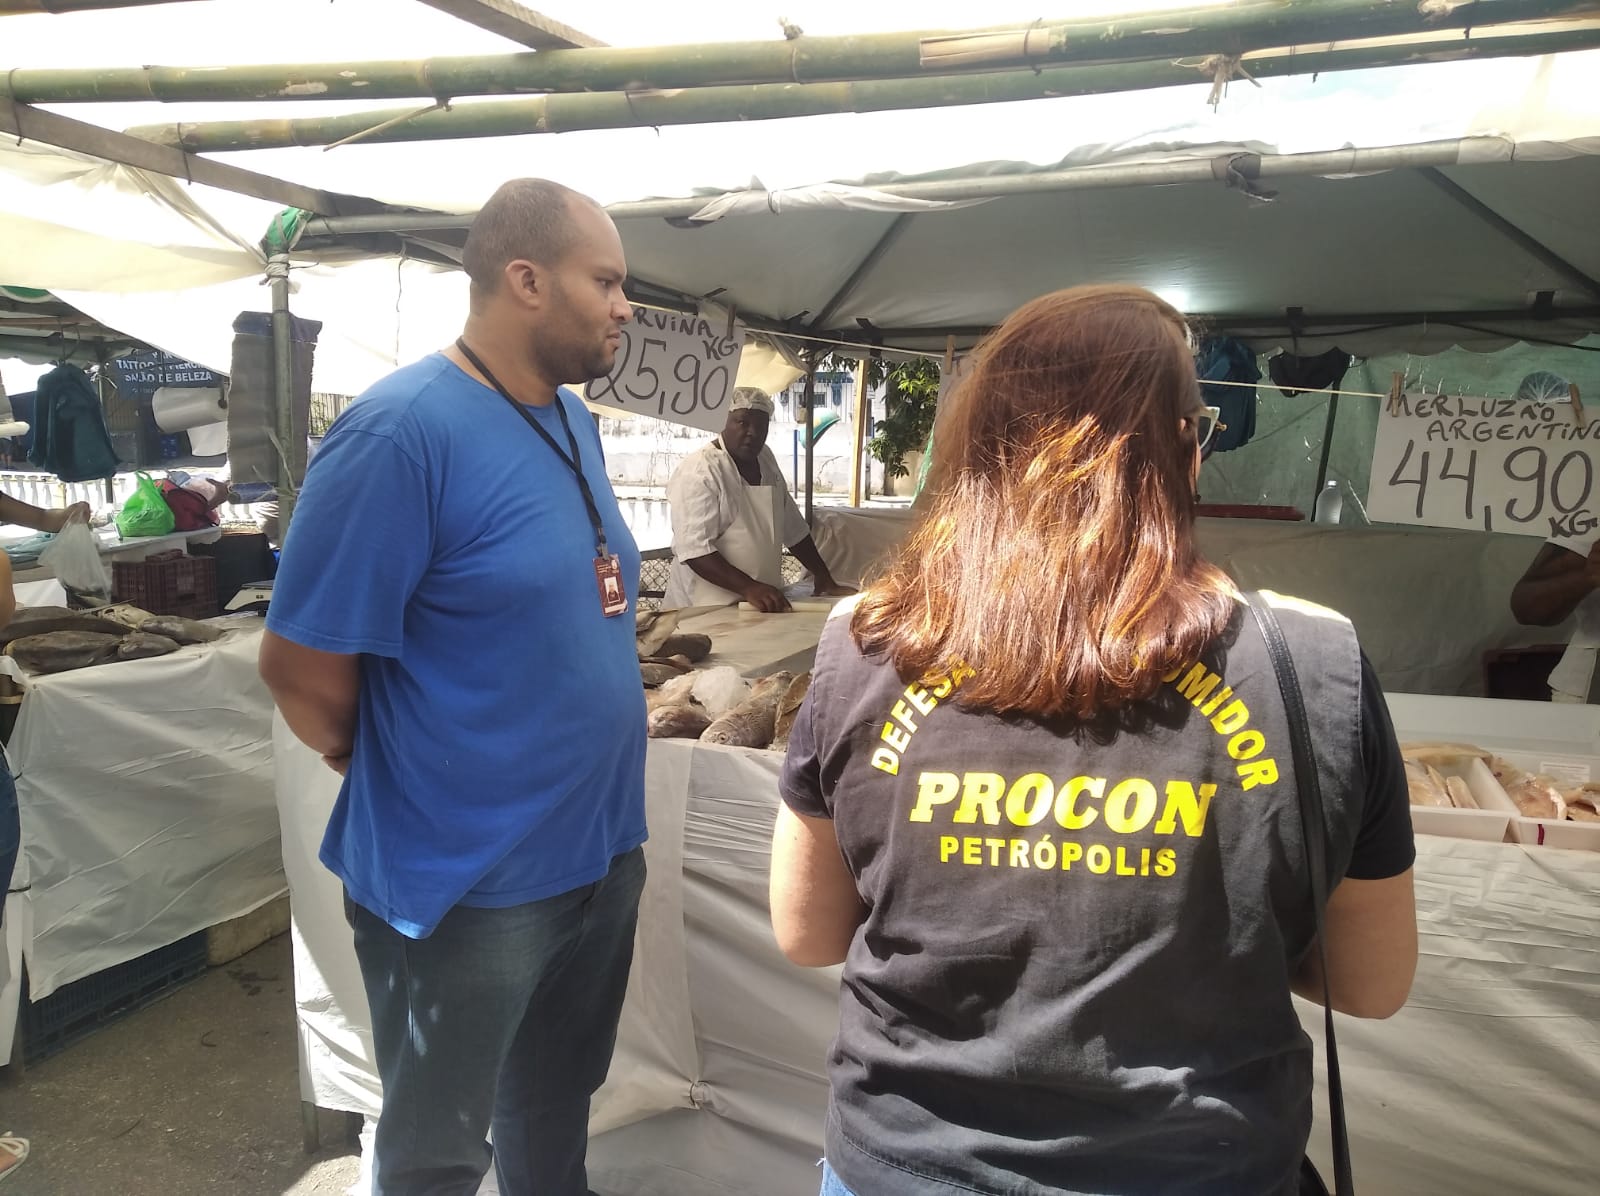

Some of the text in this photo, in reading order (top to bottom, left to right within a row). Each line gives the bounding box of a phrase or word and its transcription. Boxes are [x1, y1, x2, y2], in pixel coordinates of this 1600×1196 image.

[633, 307, 713, 338] RVINA
[703, 336, 738, 361] KG
[175, 371, 212, 382] BELEZA
[586, 330, 728, 415] 25,90
[1389, 439, 1593, 532] 44,90
[1548, 509, 1598, 538] KG
[871, 650, 1279, 792] DEFESA MIDOR
[909, 771, 1218, 837] PROCON
[939, 834, 1177, 877] PETRÓPOLIS
